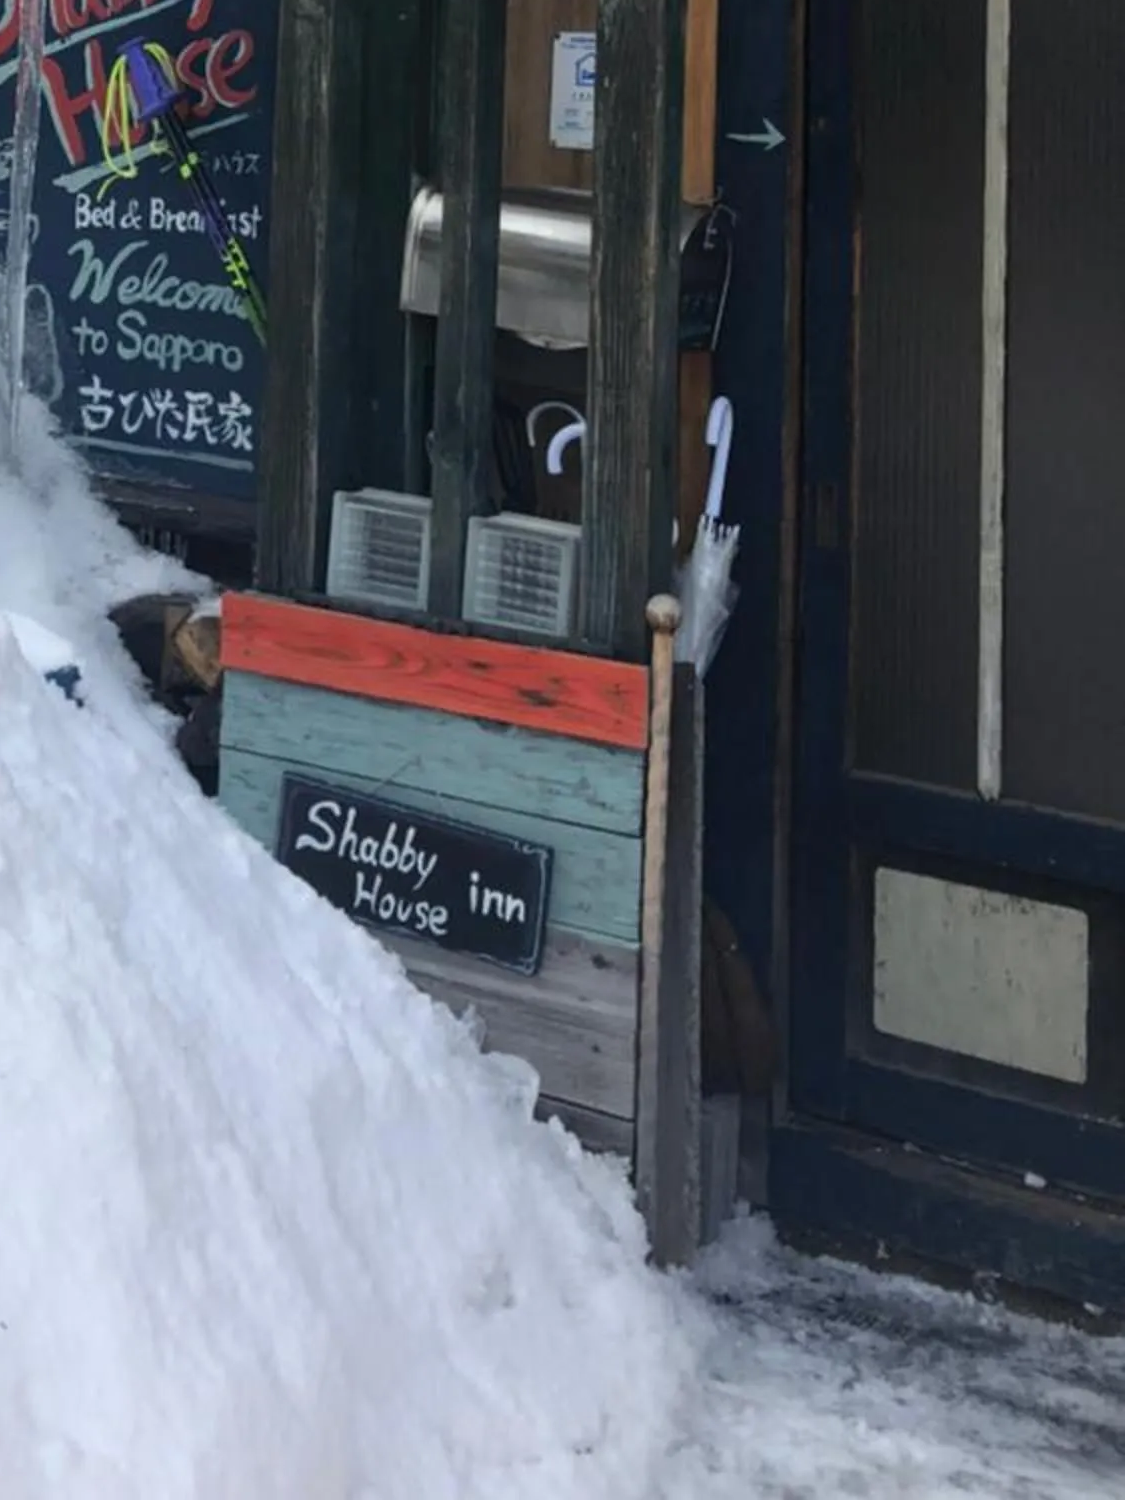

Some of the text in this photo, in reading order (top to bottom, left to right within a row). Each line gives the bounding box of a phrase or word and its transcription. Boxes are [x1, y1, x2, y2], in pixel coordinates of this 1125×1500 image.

[40, 30, 259, 166] Hse
[75, 194, 116, 229] Bed
[120, 199, 143, 230] &
[72, 309, 244, 372] to Sapporo
[78, 374, 253, 451] 古びた民家
[295, 801, 438, 891] Shabby
[354, 871, 527, 936] House inn
